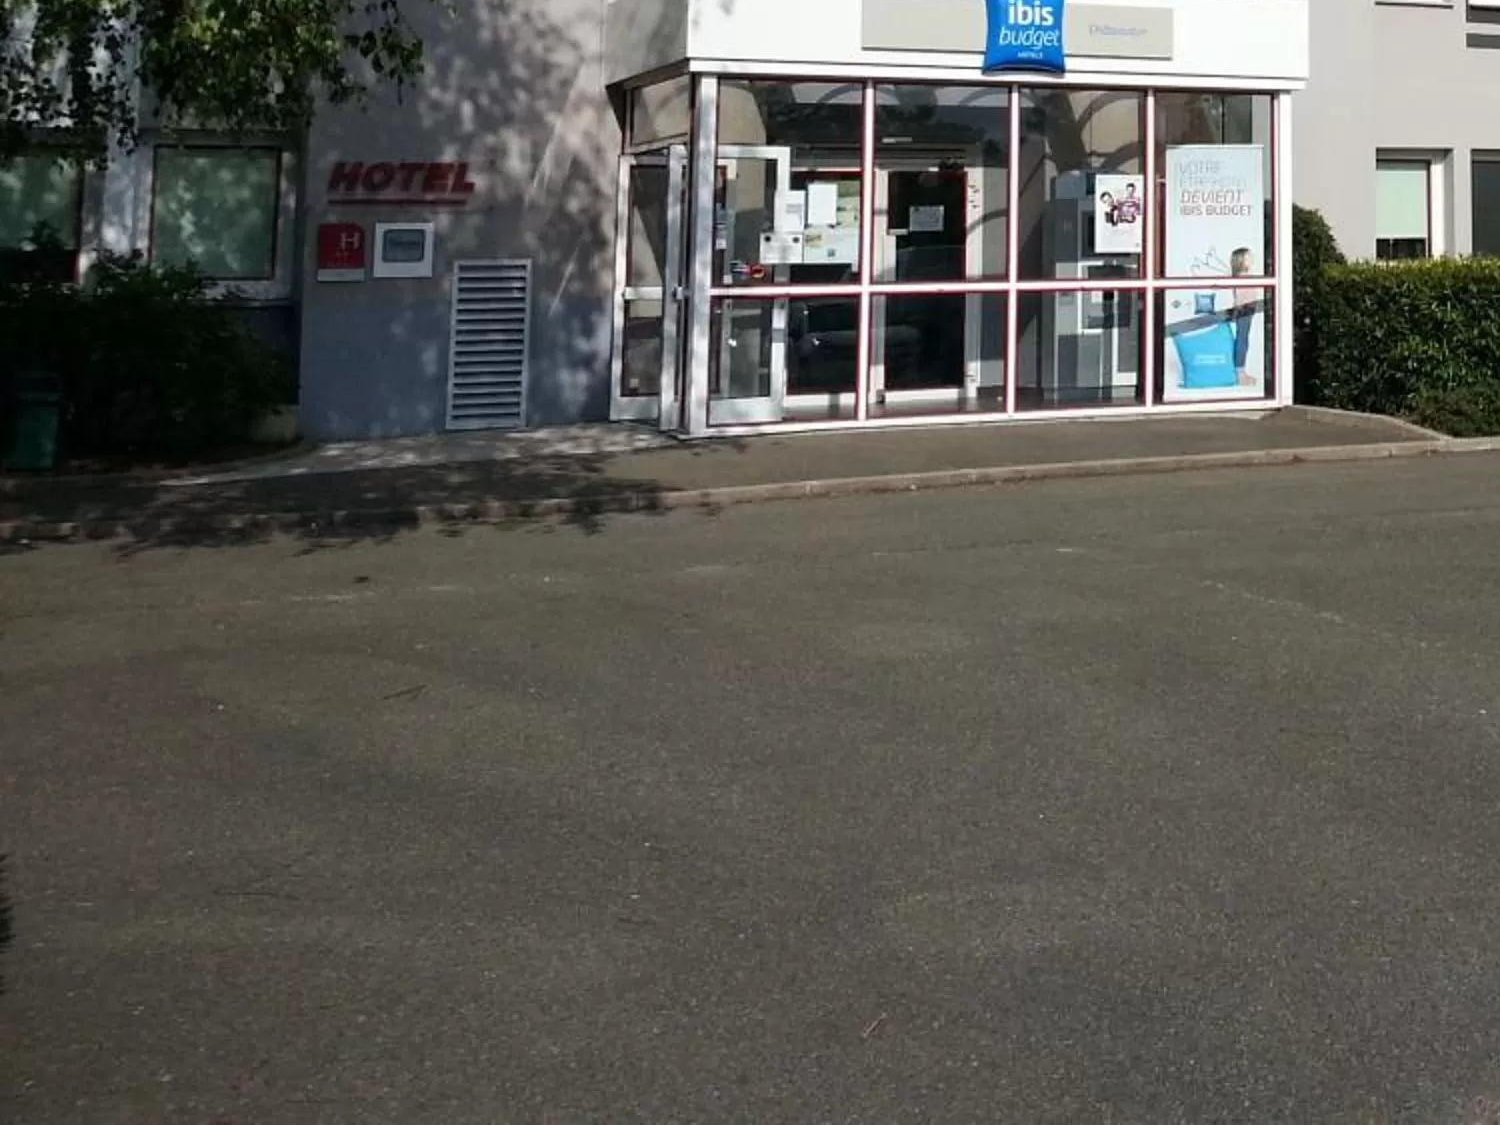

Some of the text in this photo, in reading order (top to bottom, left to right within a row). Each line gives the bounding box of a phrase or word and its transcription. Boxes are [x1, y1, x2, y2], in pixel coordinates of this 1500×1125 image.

[999, 27, 1060, 50] budget
[327, 161, 476, 194] HOTEL
[1180, 189, 1244, 204] DEVIENT
[1180, 205, 1252, 216] IBIS BUDGET
[340, 231, 361, 251] H
